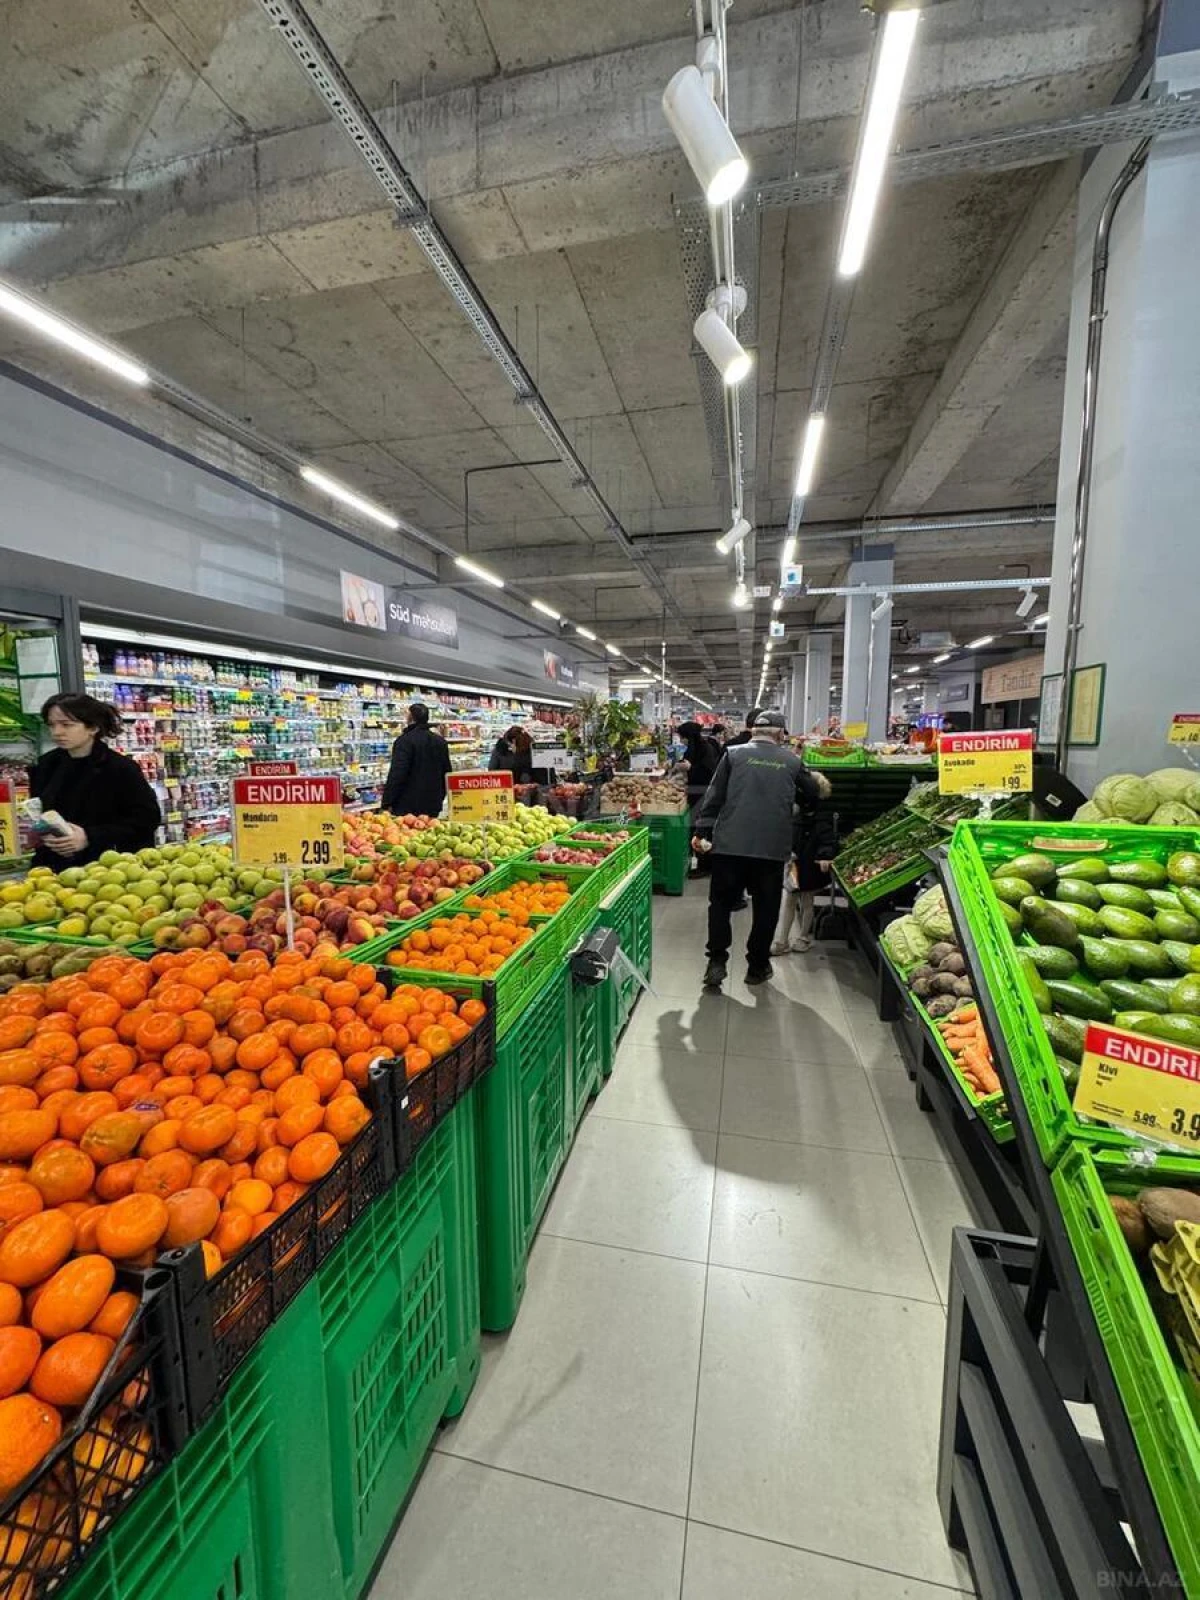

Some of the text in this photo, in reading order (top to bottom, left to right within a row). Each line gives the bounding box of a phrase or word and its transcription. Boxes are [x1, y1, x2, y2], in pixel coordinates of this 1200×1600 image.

[389, 603, 410, 623] Süd
[951, 735, 1020, 752] ENDİRİM
[255, 764, 291, 776] ENDİRİM
[944, 758, 976, 767] Avokado
[458, 775, 501, 789] ENDİRİM
[247, 780, 326, 803] ENDİRİM
[242, 811, 278, 823] Mandarin
[301, 840, 330, 865] 2.99
[1105, 1038, 1200, 1081] ENDİRİ
[1132, 1110, 1157, 1128] 5.99
